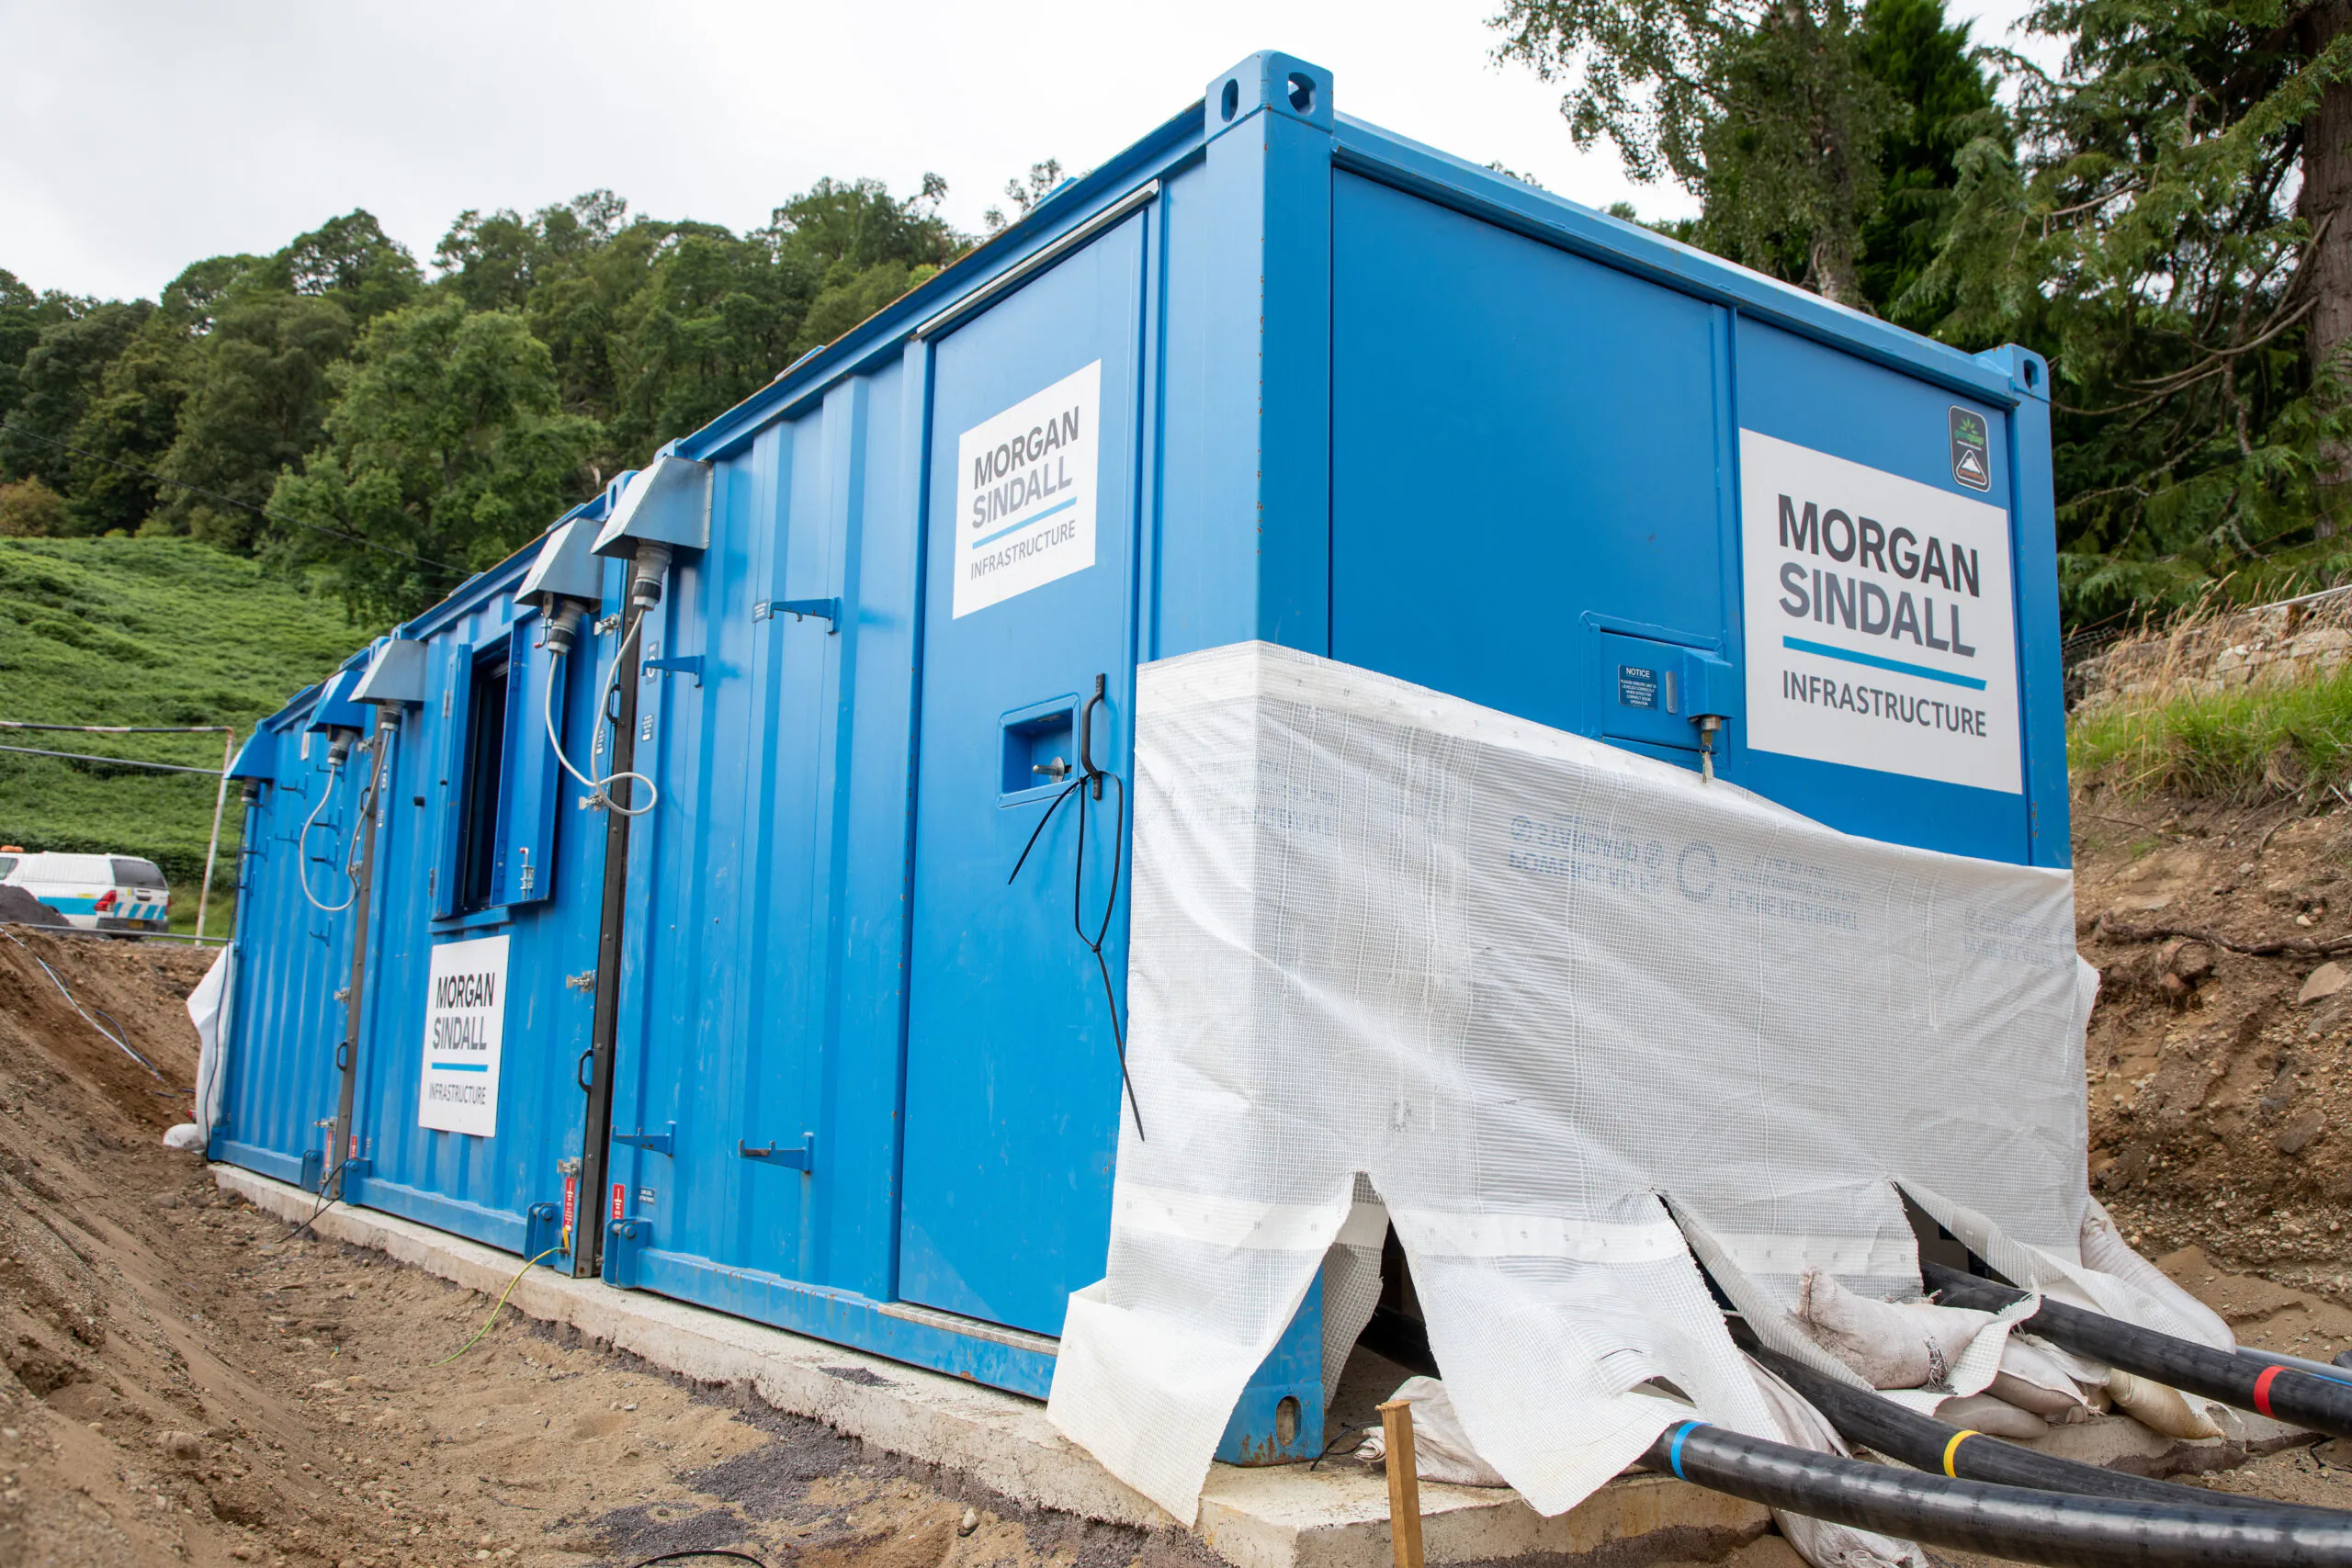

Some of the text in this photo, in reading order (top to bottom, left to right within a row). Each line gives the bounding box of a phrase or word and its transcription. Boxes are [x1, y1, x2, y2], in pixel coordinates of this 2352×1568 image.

[974, 405, 1080, 490] MORGAN
[972, 456, 1073, 529] SINDALL
[970, 519, 1076, 581] INFRASTRUCTURE
[1779, 493, 1980, 598] MORGAN
[1779, 562, 1976, 658] SINDALL
[1625, 667, 1650, 677] NOTICE
[1783, 670, 1987, 738] INFRASTRUCTURE
[435, 972, 495, 1009] MORGAN
[433, 1016, 487, 1050] SINDALL
[429, 1082, 487, 1105] INFRASTRUCTURE
